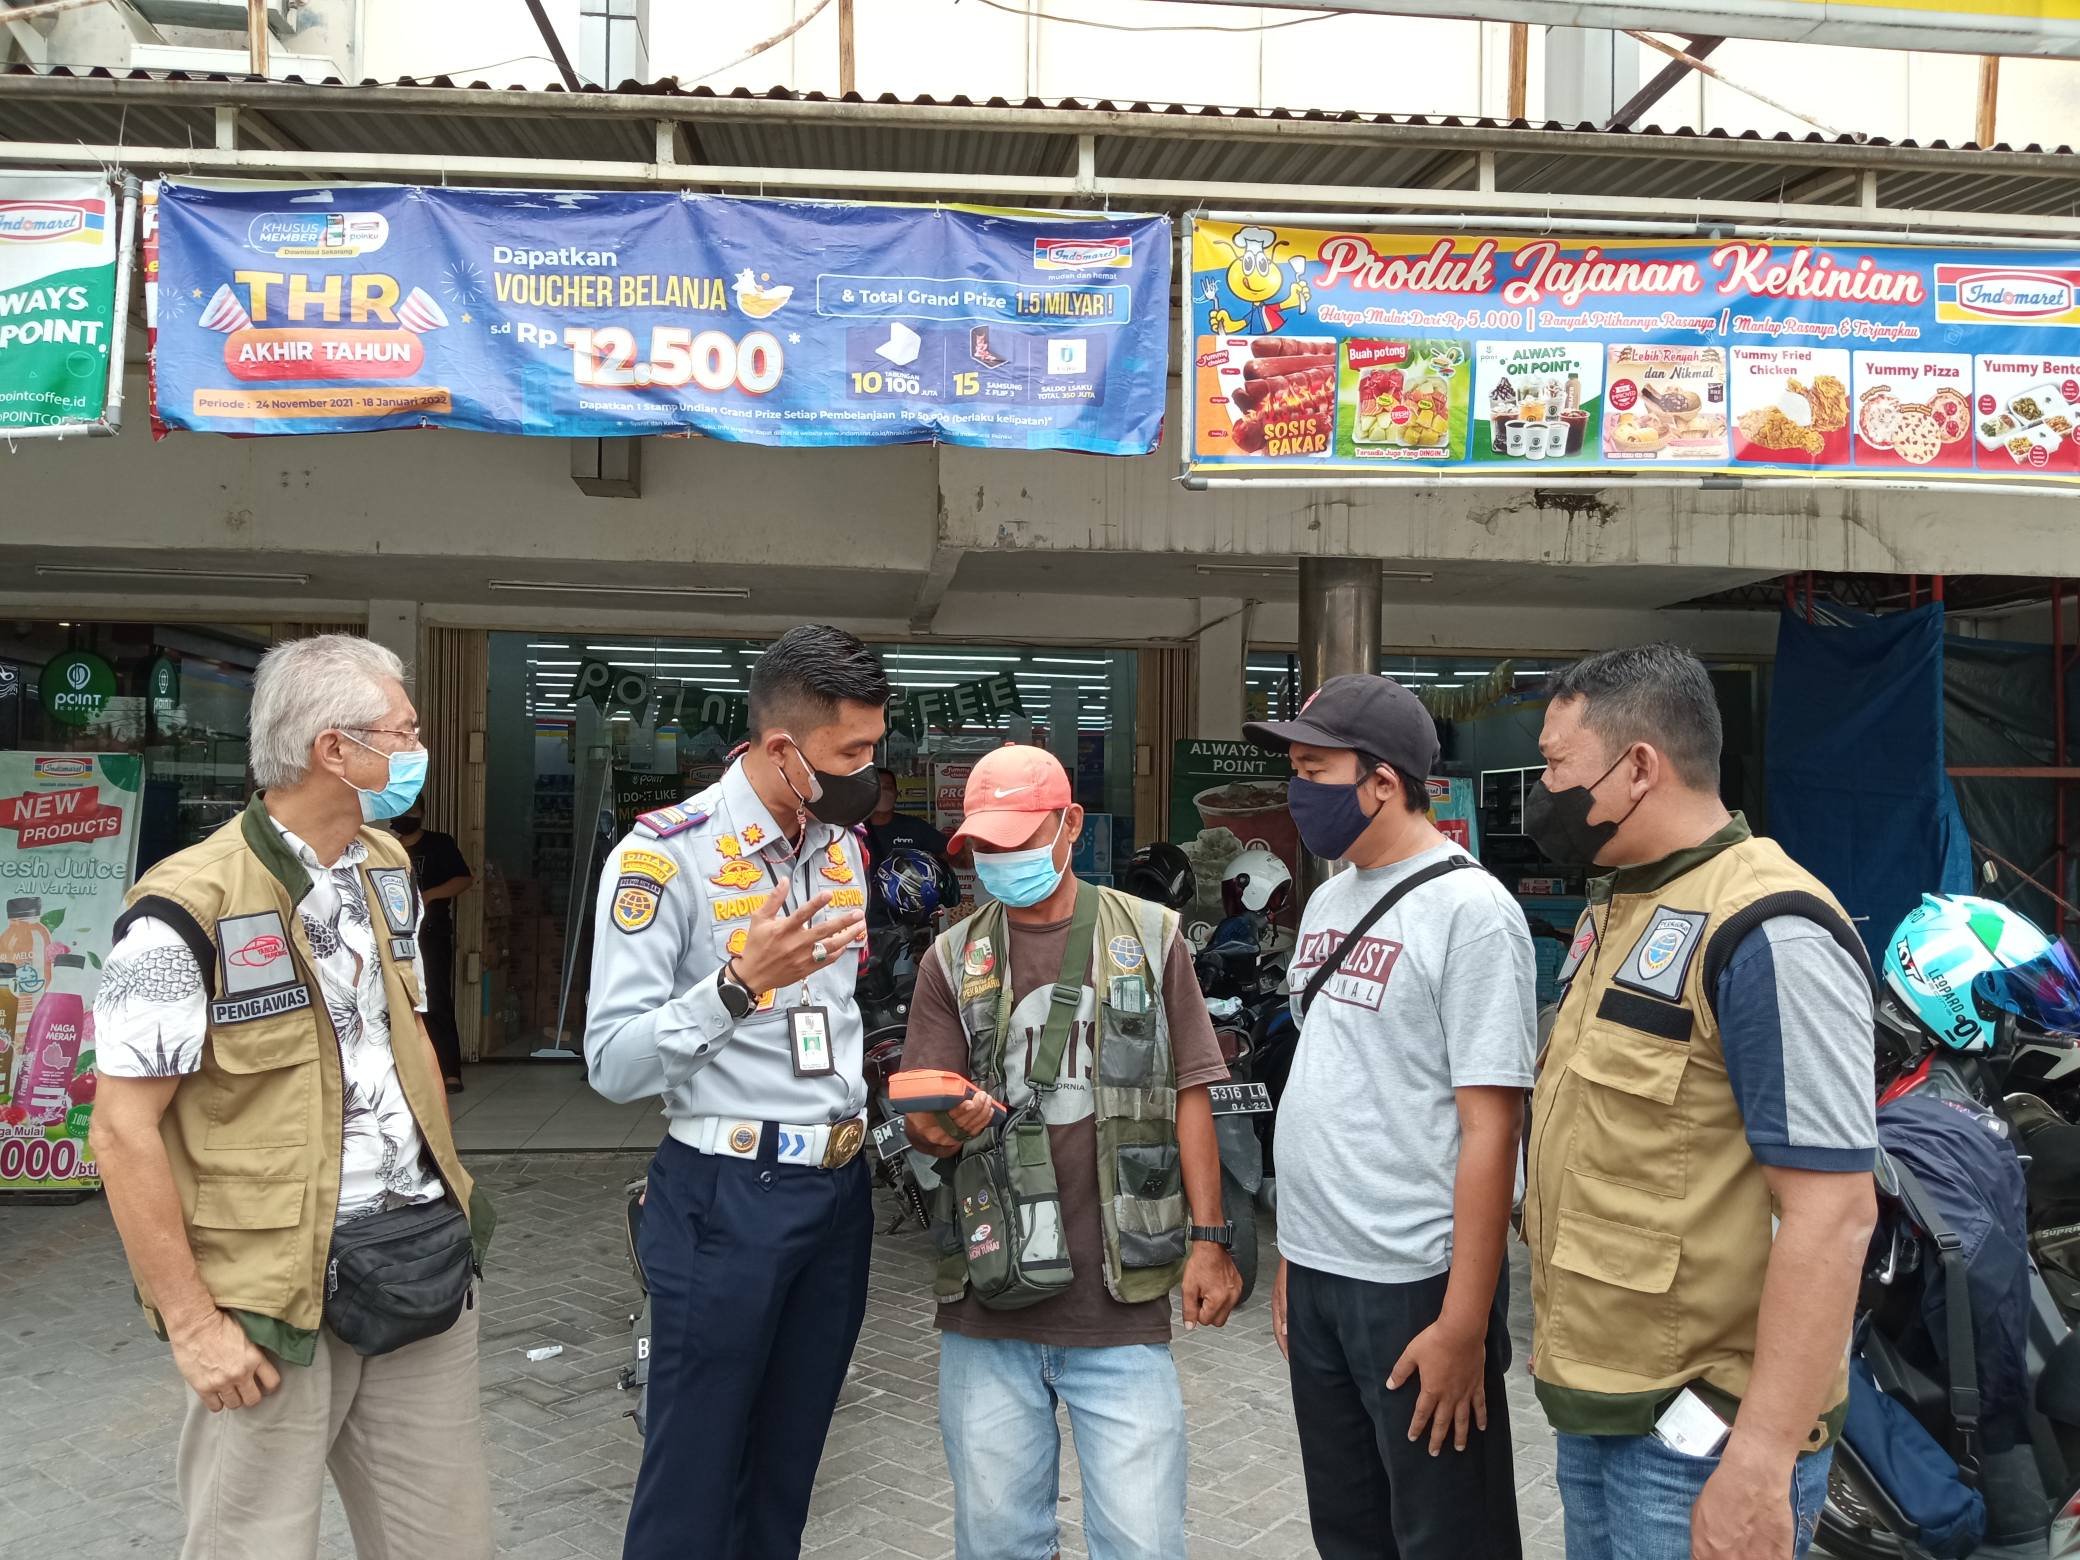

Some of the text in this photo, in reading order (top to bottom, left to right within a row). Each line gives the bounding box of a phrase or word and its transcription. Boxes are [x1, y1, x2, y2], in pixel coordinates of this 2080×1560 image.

[262, 223, 318, 233] KHUSUS
[259, 233, 318, 242] MEMBER
[494, 246, 617, 269] Dapatkan
[1052, 248, 1113, 261] Indomaret
[1092, 273, 1117, 281] hemat
[1317, 236, 1922, 306] Produk Jajanan Kekinian
[234, 269, 401, 324] THR
[494, 272, 727, 312] VOUCHER BELANJA
[1966, 283, 2066, 307] Indomaret
[842, 290, 855, 302] &
[859, 289, 903, 303] Total
[907, 291, 959, 306] Grand
[964, 292, 1007, 308] Prize
[1015, 291, 1040, 314] 1.5
[1044, 294, 1104, 316] MILYAR
[1319, 307, 1521, 330] Harga Mulai Dari Rp 5.000
[1541, 312, 1716, 333] Banyak Pilihannya Rasanya
[490, 322, 511, 335] s.d
[517, 322, 557, 349] Rp
[1787, 319, 1836, 338] Rasanya
[1853, 321, 1920, 340] Terjangkau
[239, 341, 411, 362] AKHIR TAHUN
[1349, 346, 1406, 360] Buah potong
[1512, 346, 1566, 361] ALWAYS
[1632, 349, 1699, 365] Lebih Renyah
[1734, 349, 1812, 362] Yummy Fried
[1506, 360, 1572, 376] ON POINT
[1644, 366, 1714, 380] dan Nikmat
[1749, 365, 1798, 375] Chicken
[1866, 362, 1960, 379] Yummy Pizza
[1984, 359, 2039, 377] Yummy
[851, 371, 883, 394] 10
[885, 377, 938, 398] 100 JUTA
[953, 371, 981, 396] 15
[986, 382, 1023, 391] SAMSUNG
[1041, 385, 1067, 393] SALDO
[199, 398, 244, 410] Periode
[256, 400, 270, 409] 24
[271, 399, 327, 410] November
[330, 398, 353, 408] 2021
[362, 398, 374, 407] 18
[376, 397, 418, 407] Januari
[420, 395, 447, 406] 2022
[1077, 391, 1096, 400] JUTA
[579, 401, 634, 412] Dapatkan
[642, 403, 678, 413] Stamp
[680, 403, 717, 413] Undian
[720, 407, 752, 418] Grand
[755, 409, 781, 419] Prize
[784, 410, 817, 422] Setiap
[820, 410, 896, 421] Pembelanjaan
[901, 410, 916, 422] Rp
[952, 413, 993, 424] (berlaku
[1264, 418, 1317, 440] SOSIS
[1268, 434, 1326, 457] BAKAR
[1385, 449, 1401, 457] Juga
[1402, 449, 1418, 457] Yang
[1190, 742, 1260, 757] ALWAYS
[1213, 759, 1267, 774] POINT
[653, 784, 676, 797] LIKE
[13, 791, 80, 821] NEW
[23, 816, 118, 842] PRODUCTS
[55, 856, 128, 879] Juice
[15, 880, 97, 895] All Variant
[1928, 968, 1965, 1014] LEOPARD
[215, 989, 307, 1021] PENGAWAS
[46, 1032, 76, 1041] MERAH
[50, 1023, 75, 1033] NAGA
[1210, 1086, 1242, 1100] 5316
[14, 1126, 44, 1136] Mulai
[875, 1125, 894, 1145] BM
[638, 1338, 650, 1359] B
